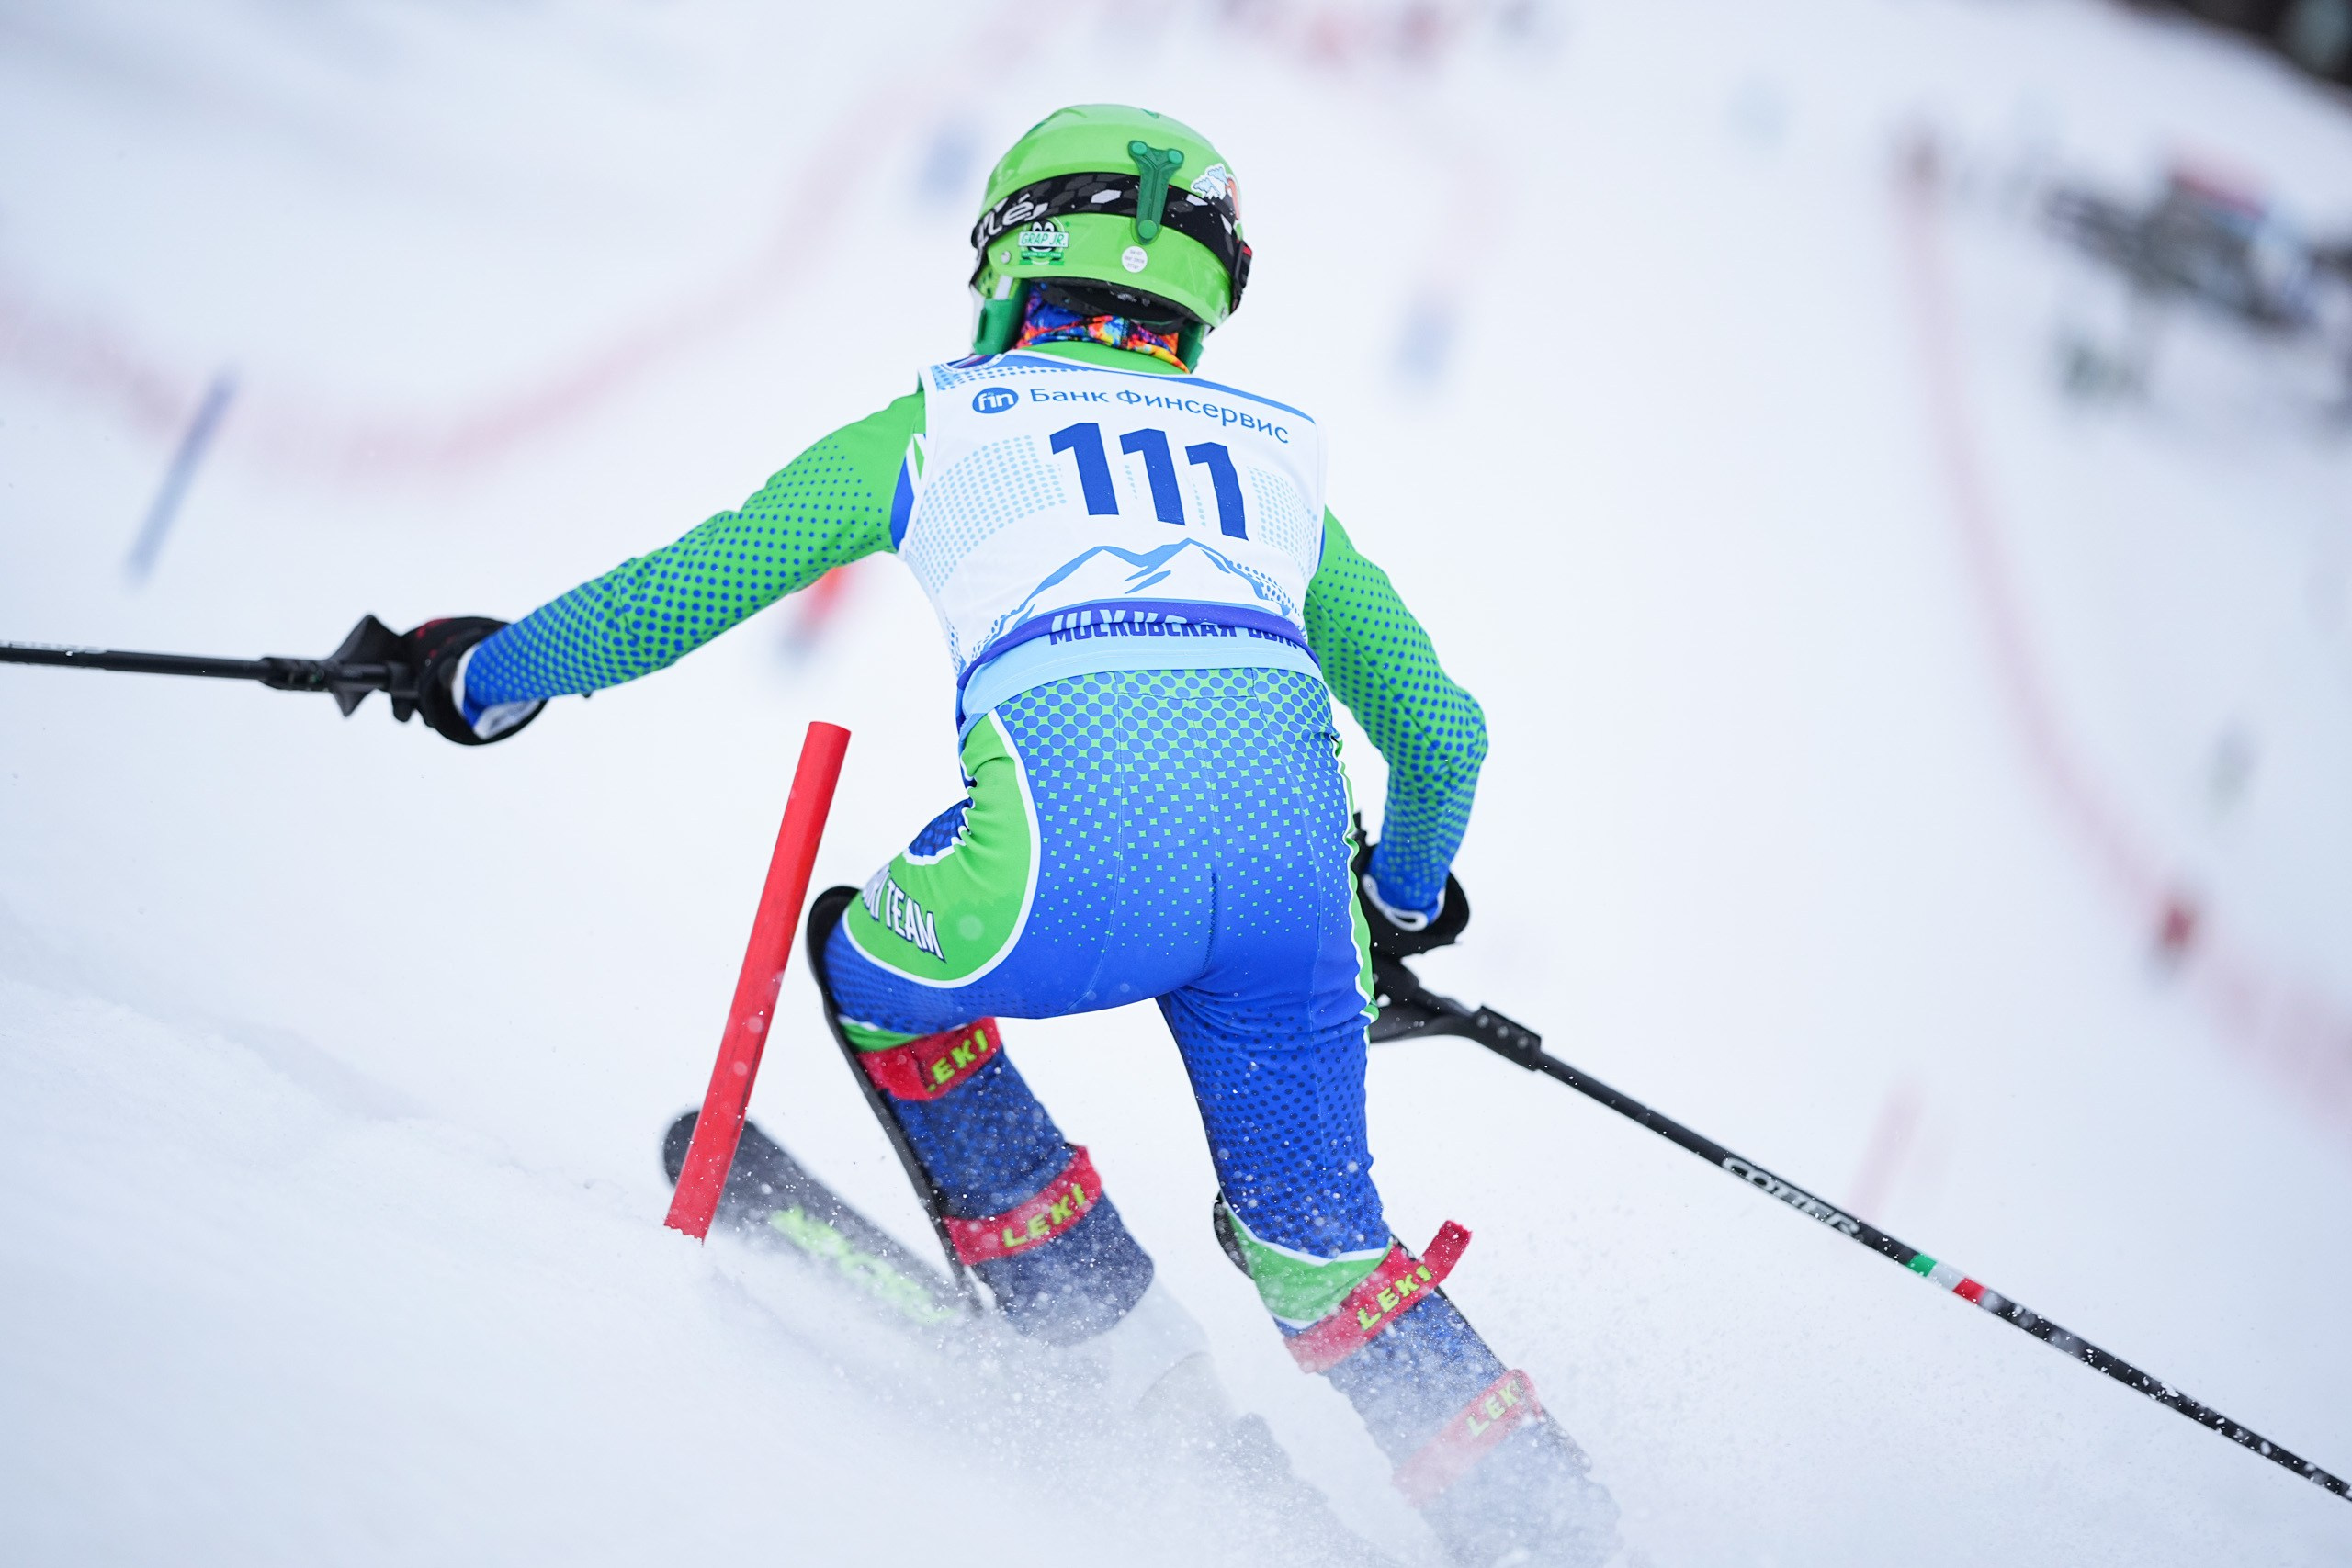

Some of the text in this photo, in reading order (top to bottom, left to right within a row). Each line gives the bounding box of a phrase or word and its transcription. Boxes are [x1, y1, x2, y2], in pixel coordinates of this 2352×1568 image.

[1021, 232, 1066, 246] GRAP JR.
[977, 392, 1014, 412] fin
[1029, 388, 1289, 444] Банк Финсервис
[1049, 423, 1250, 542] 111
[885, 877, 947, 964] TEAM
[927, 1028, 989, 1093] EKI
[1001, 1183, 1086, 1248] LEKI
[1357, 1266, 1434, 1331] LEKI
[1465, 1379, 1522, 1438] LEK
